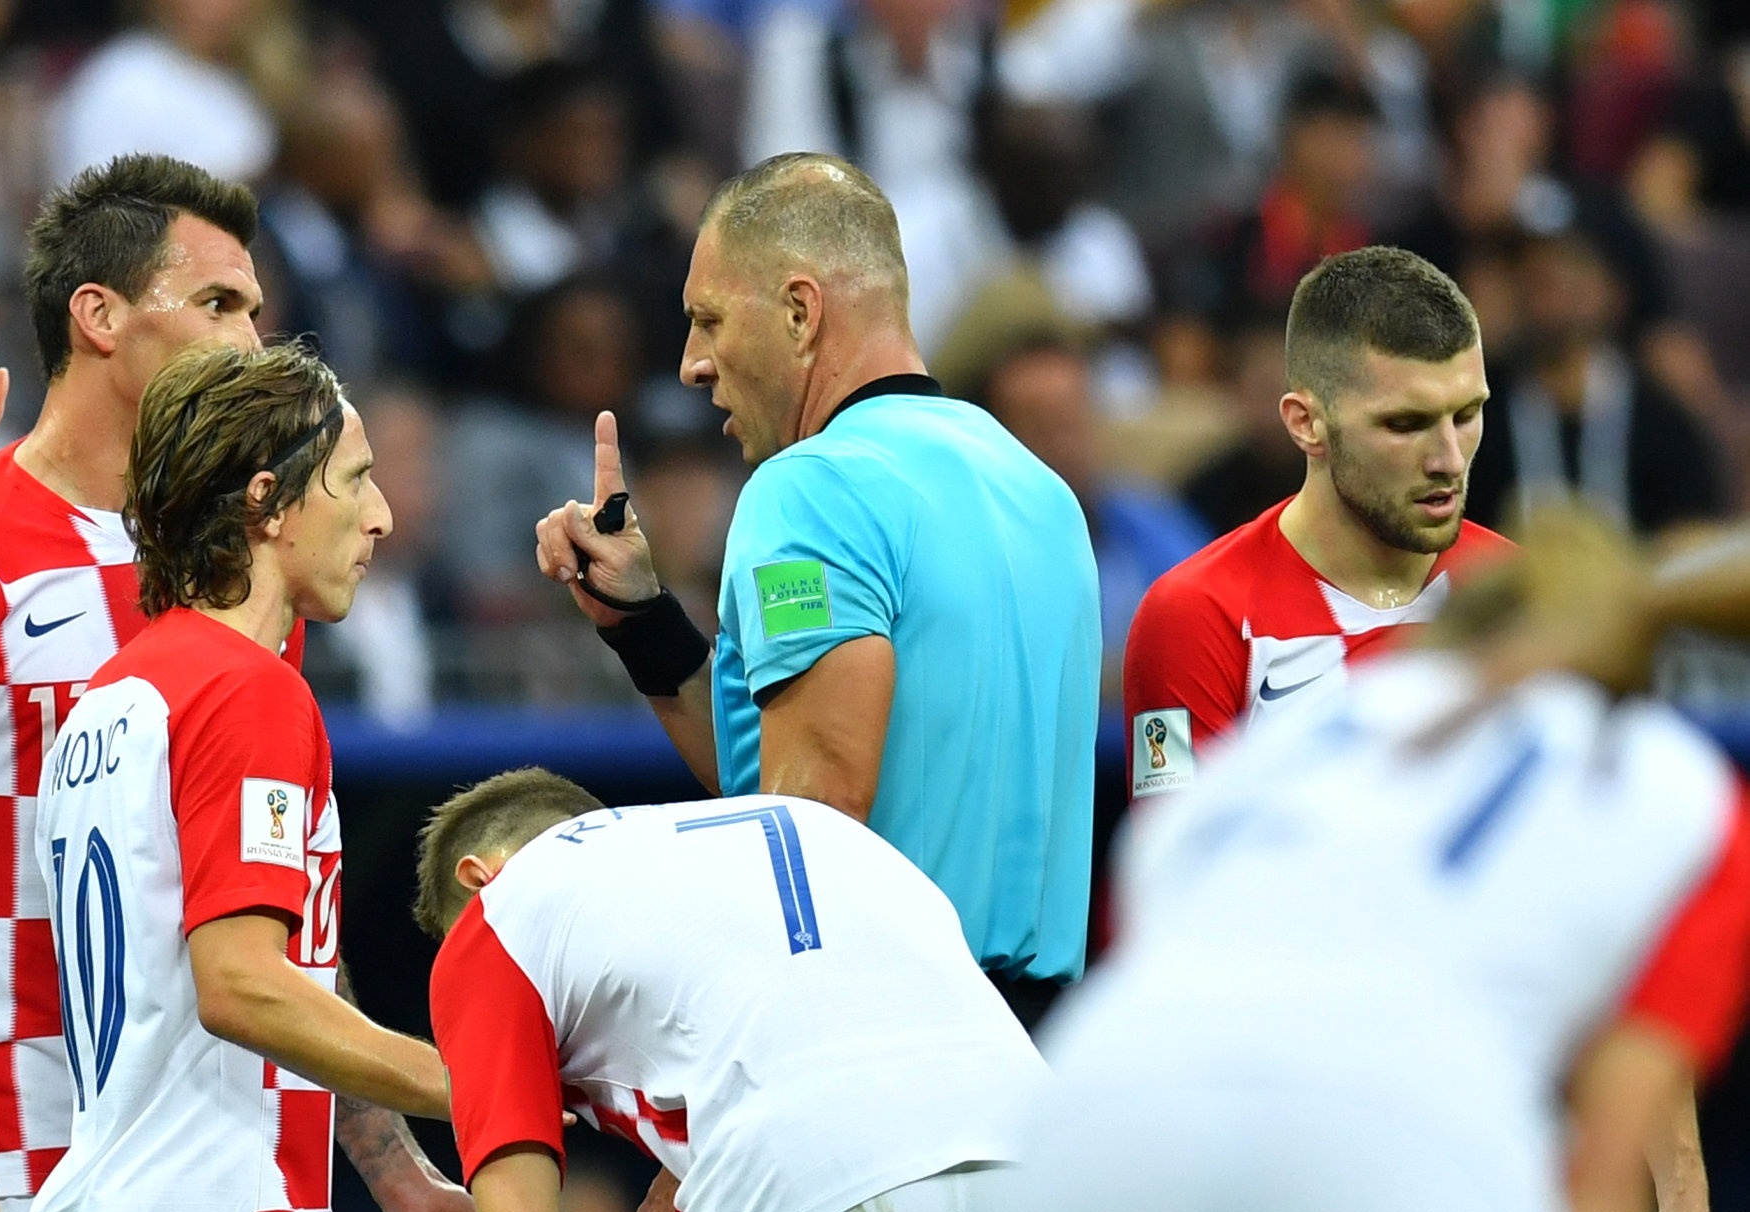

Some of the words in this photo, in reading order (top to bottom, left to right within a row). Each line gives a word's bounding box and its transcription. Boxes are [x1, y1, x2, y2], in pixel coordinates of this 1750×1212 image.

[762, 577, 821, 595] LIVING
[800, 601, 824, 611] FIFA
[246, 846, 283, 858] RUSSIA
[674, 804, 823, 956] 7
[51, 826, 126, 1113] 10
